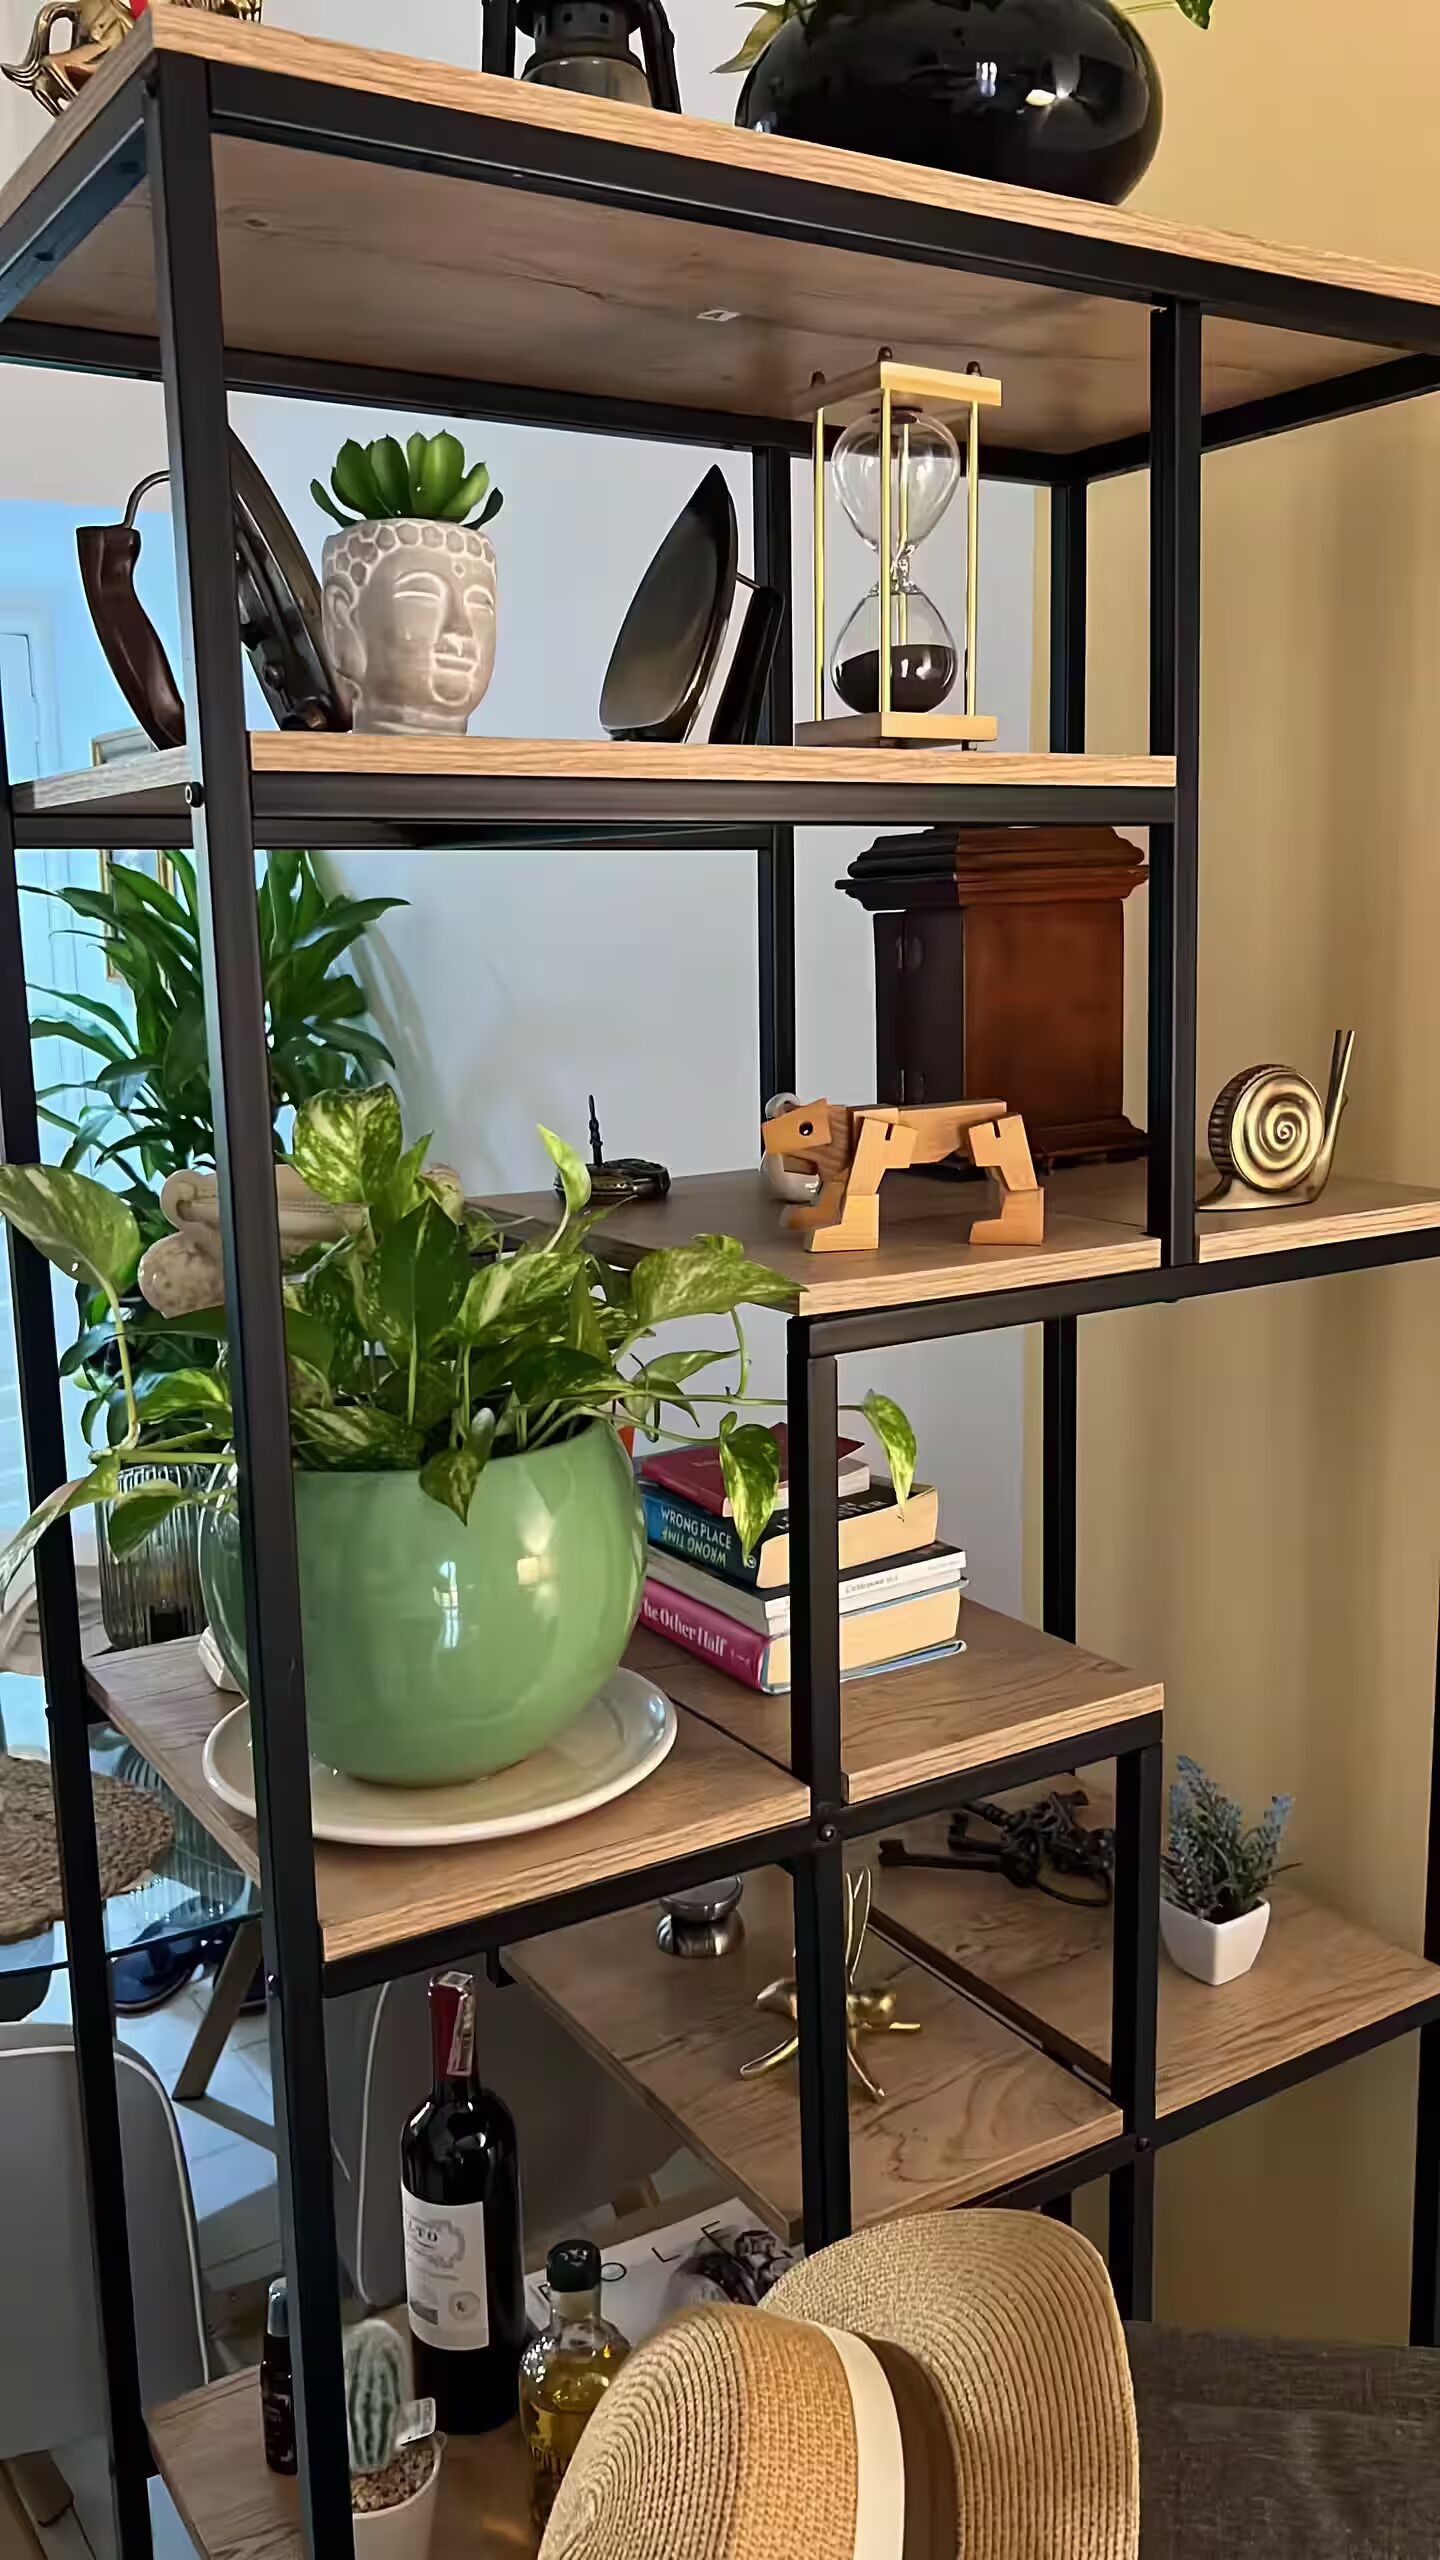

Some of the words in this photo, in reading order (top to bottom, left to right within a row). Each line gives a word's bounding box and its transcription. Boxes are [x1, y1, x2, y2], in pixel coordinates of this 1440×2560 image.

[660, 1507, 698, 1537] WRONG
[700, 1523, 732, 1550] PLACE
[687, 1537, 727, 1568] WRONG
[641, 1597, 659, 1622] he
[659, 1607, 697, 1641] Other
[696, 1627, 728, 1657] Half
